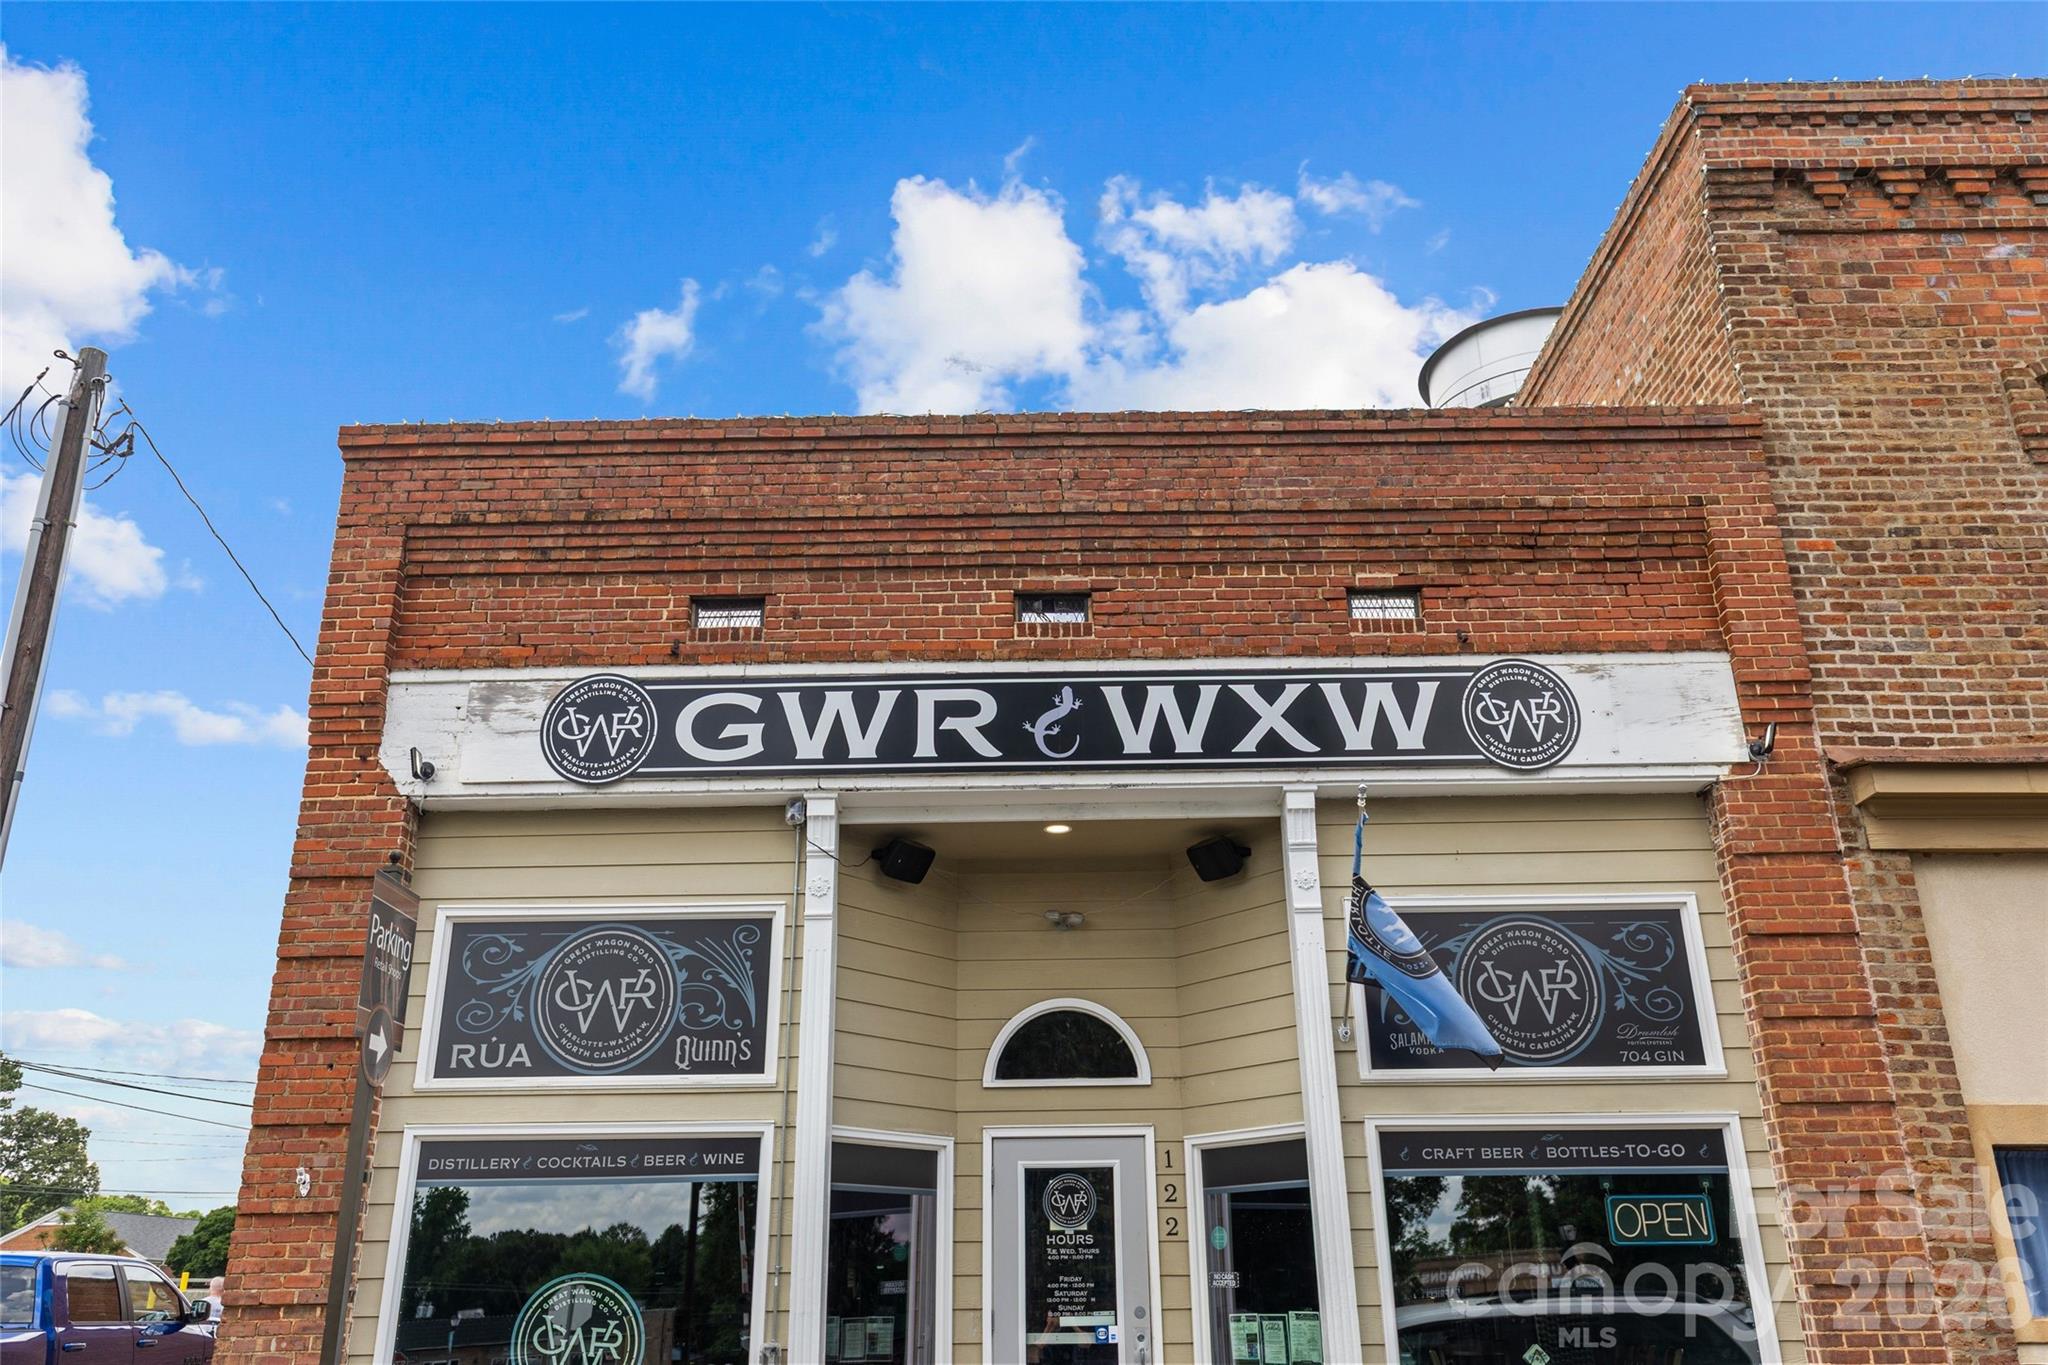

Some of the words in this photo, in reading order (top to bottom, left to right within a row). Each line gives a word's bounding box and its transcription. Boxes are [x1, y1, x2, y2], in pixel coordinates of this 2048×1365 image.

[1477, 671, 1499, 689] GREAT
[1533, 673, 1554, 688] ROAD
[1488, 675, 1528, 689] DISTILLING
[565, 685, 589, 704] GREAT
[622, 688, 641, 703] ROAD
[576, 690, 616, 703] DISTILLING
[675, 688, 1003, 762] GWR
[1100, 681, 1440, 754] WXW
[1489, 745, 1517, 761] NORTH
[1520, 745, 1560, 762] CAROLINA
[562, 760, 588, 776] NORTH
[590, 760, 632, 777] CAROLINA
[370, 913, 412, 971] Parking
[1478, 933, 1503, 956] GREAT
[1505, 930, 1542, 939] WAGON
[1544, 935, 1569, 955] ROAD
[1491, 939, 1538, 956] DISTILLING
[564, 943, 592, 965] GREAT
[595, 939, 631, 947] WAGON
[633, 944, 654, 964] ROAD
[577, 948, 625, 965] DISTILLING
[560, 1037, 590, 1057] NORTH
[593, 1037, 643, 1058] CAROLINA
[1389, 1030, 1434, 1050] SALAM
[1493, 1029, 1526, 1048] NORTH
[1529, 1028, 1577, 1050] CAROLINA
[449, 1035, 533, 1069] RÚA
[1409, 1045, 1445, 1055] VODKA
[1619, 1050, 1651, 1062] 704
[1654, 1050, 1686, 1062] GIN
[428, 1157, 521, 1171] DISTILLERY
[536, 1155, 627, 1169] COCKTAILS
[643, 1154, 686, 1167] BEER
[702, 1152, 745, 1166] WINE
[1422, 1147, 1475, 1160] CRAFT
[1481, 1147, 1524, 1159] BEER
[1546, 1144, 1686, 1159] BOTTLES-TO-GO
[1613, 1201, 1709, 1238] OPEN
[1046, 1234, 1094, 1245] HOURS
[543, 1290, 568, 1309] GREAT
[571, 1288, 603, 1299] WAGON
[604, 1296, 623, 1316] ROAD
[554, 1298, 597, 1311] DISTILLING
